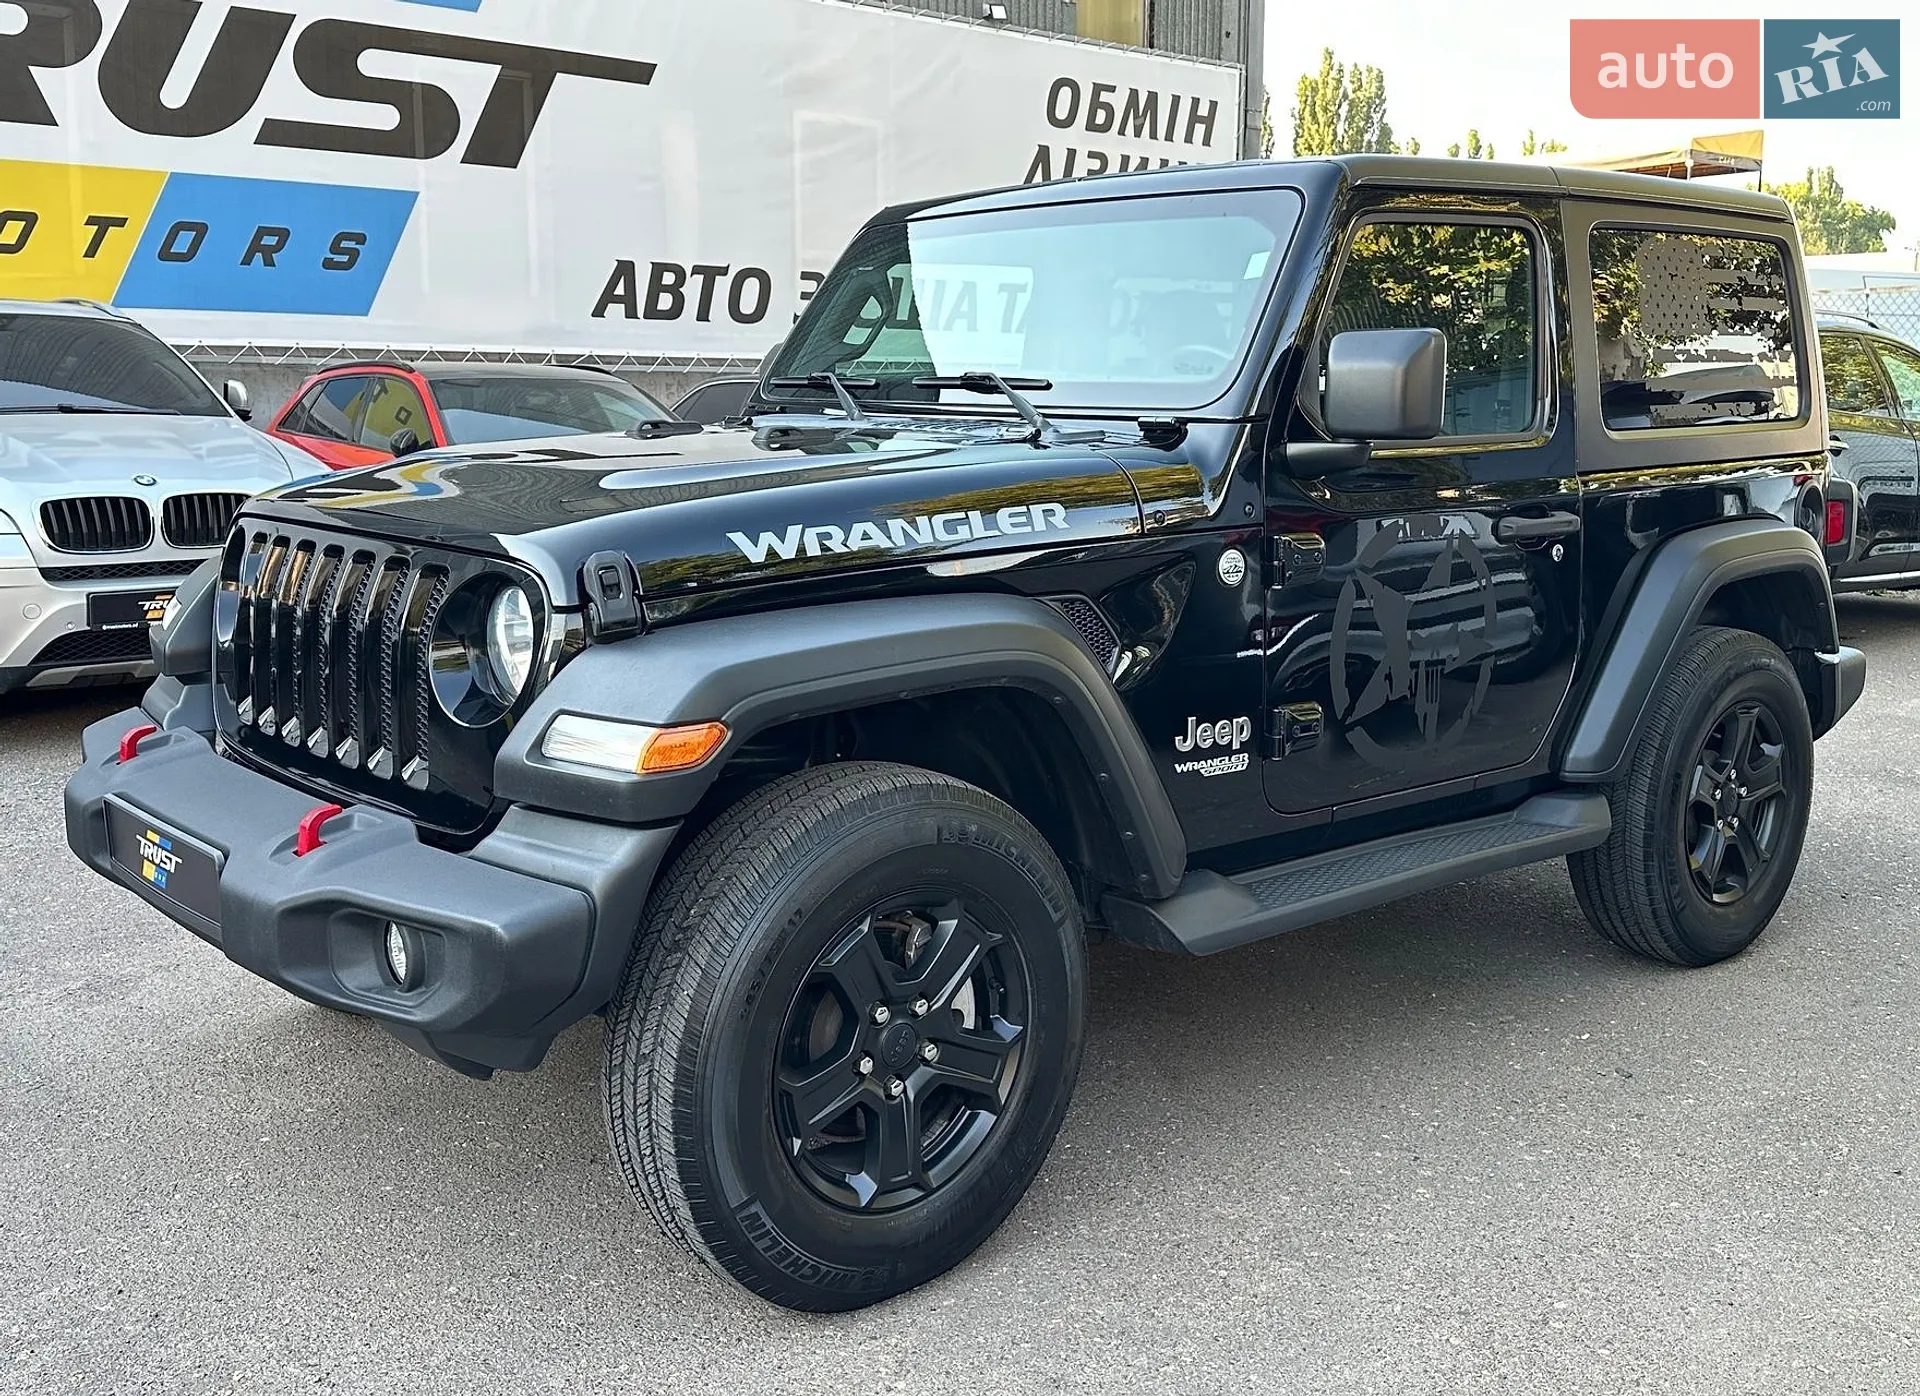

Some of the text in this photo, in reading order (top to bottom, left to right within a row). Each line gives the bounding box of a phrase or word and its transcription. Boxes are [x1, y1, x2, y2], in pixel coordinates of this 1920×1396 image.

[1046, 77, 1219, 147] ОБМІН
[591, 258, 772, 324] АВТО
[726, 502, 1071, 563] WRANGLER
[1174, 716, 1252, 752] Jeep
[1174, 752, 1249, 774] WRANGLER
[136, 834, 182, 873] TRUST
[737, 1210, 852, 1287] MICHELIN
